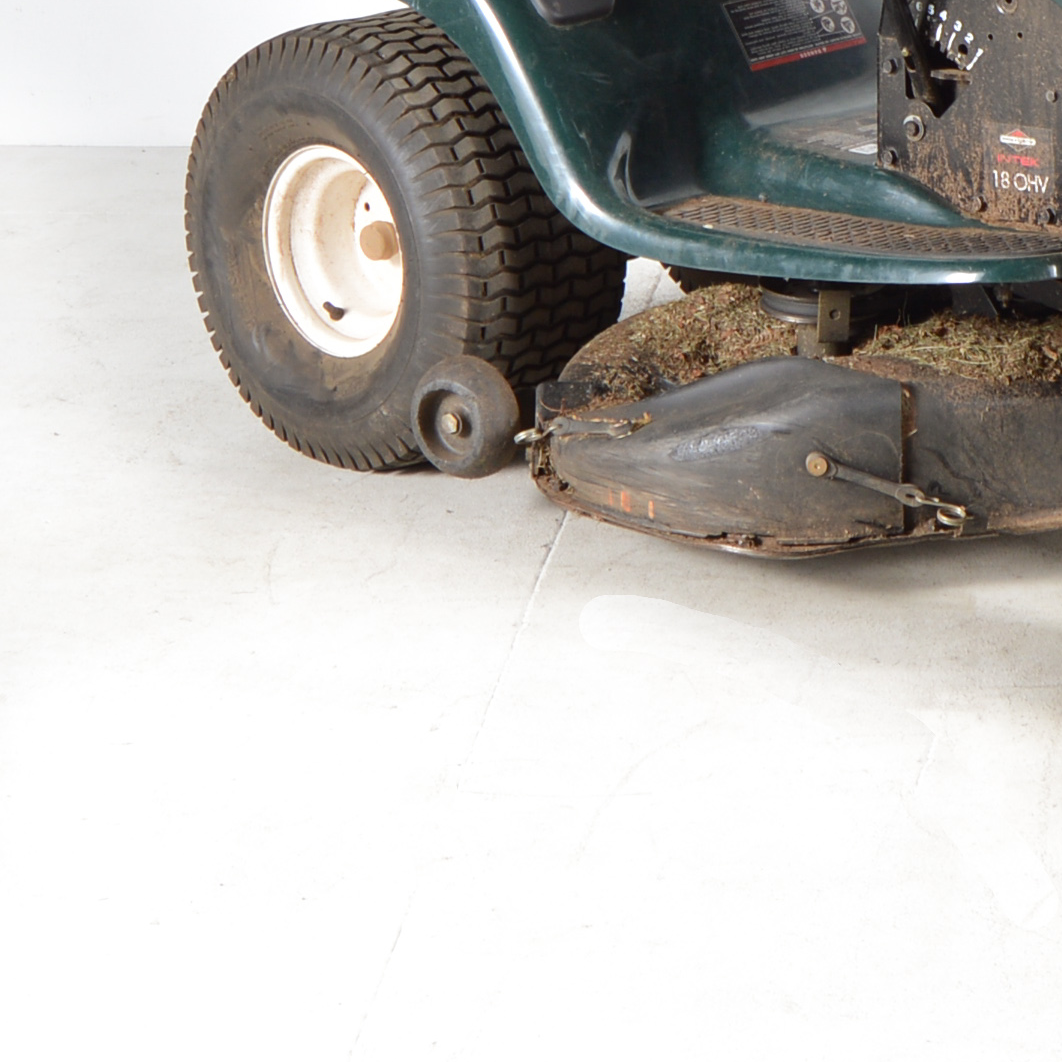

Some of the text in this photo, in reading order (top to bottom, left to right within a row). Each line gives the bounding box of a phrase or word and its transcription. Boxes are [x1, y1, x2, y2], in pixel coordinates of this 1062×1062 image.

[964, 32, 974, 45] 2
[997, 153, 1040, 167] INTEK
[993, 169, 1050, 194] 18 OHV
